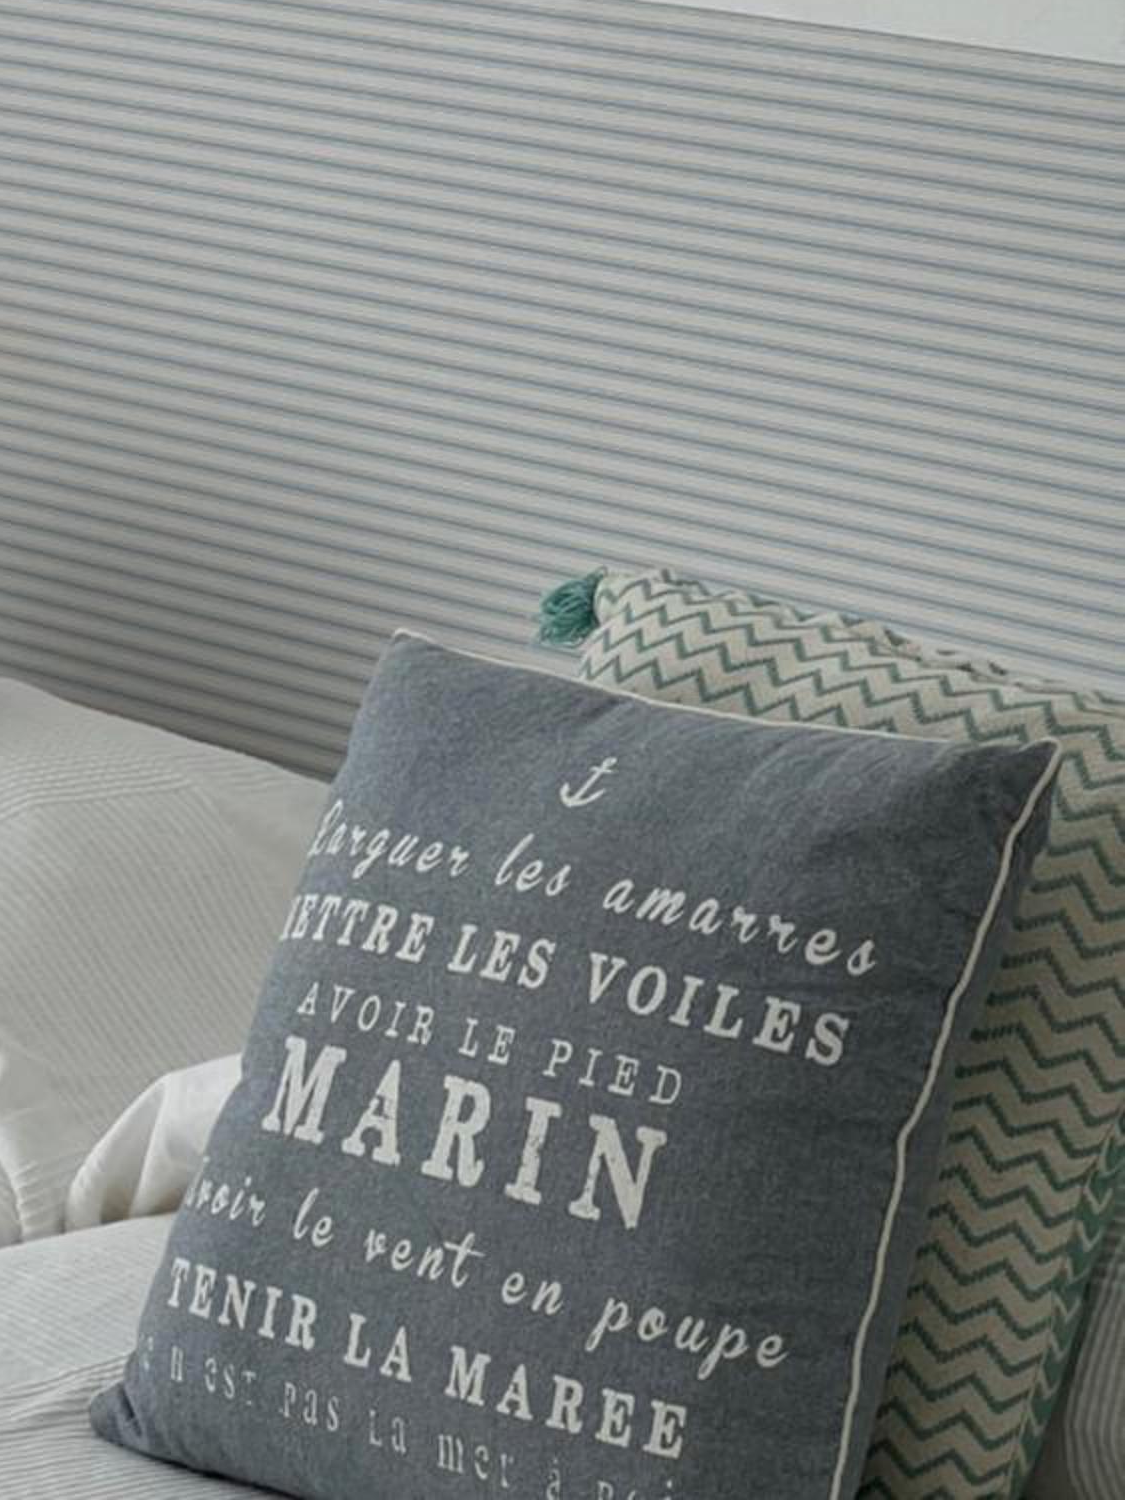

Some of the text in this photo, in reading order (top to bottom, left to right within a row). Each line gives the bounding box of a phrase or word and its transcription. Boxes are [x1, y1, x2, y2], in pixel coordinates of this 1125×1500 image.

[494, 833, 572, 896] les
[602, 878, 877, 976] amarres
[297, 981, 683, 1106] AVOIR LE PIED
[447, 923, 557, 989] LES
[589, 951, 851, 1066] VOILES
[261, 1035, 668, 1230] MARIN
[166, 1256, 688, 1460] TENIR LA MAREE
[293, 1187, 334, 1248] le
[364, 1232, 487, 1288] vent
[501, 1272, 563, 1315] en
[584, 1297, 789, 1380] poupe
